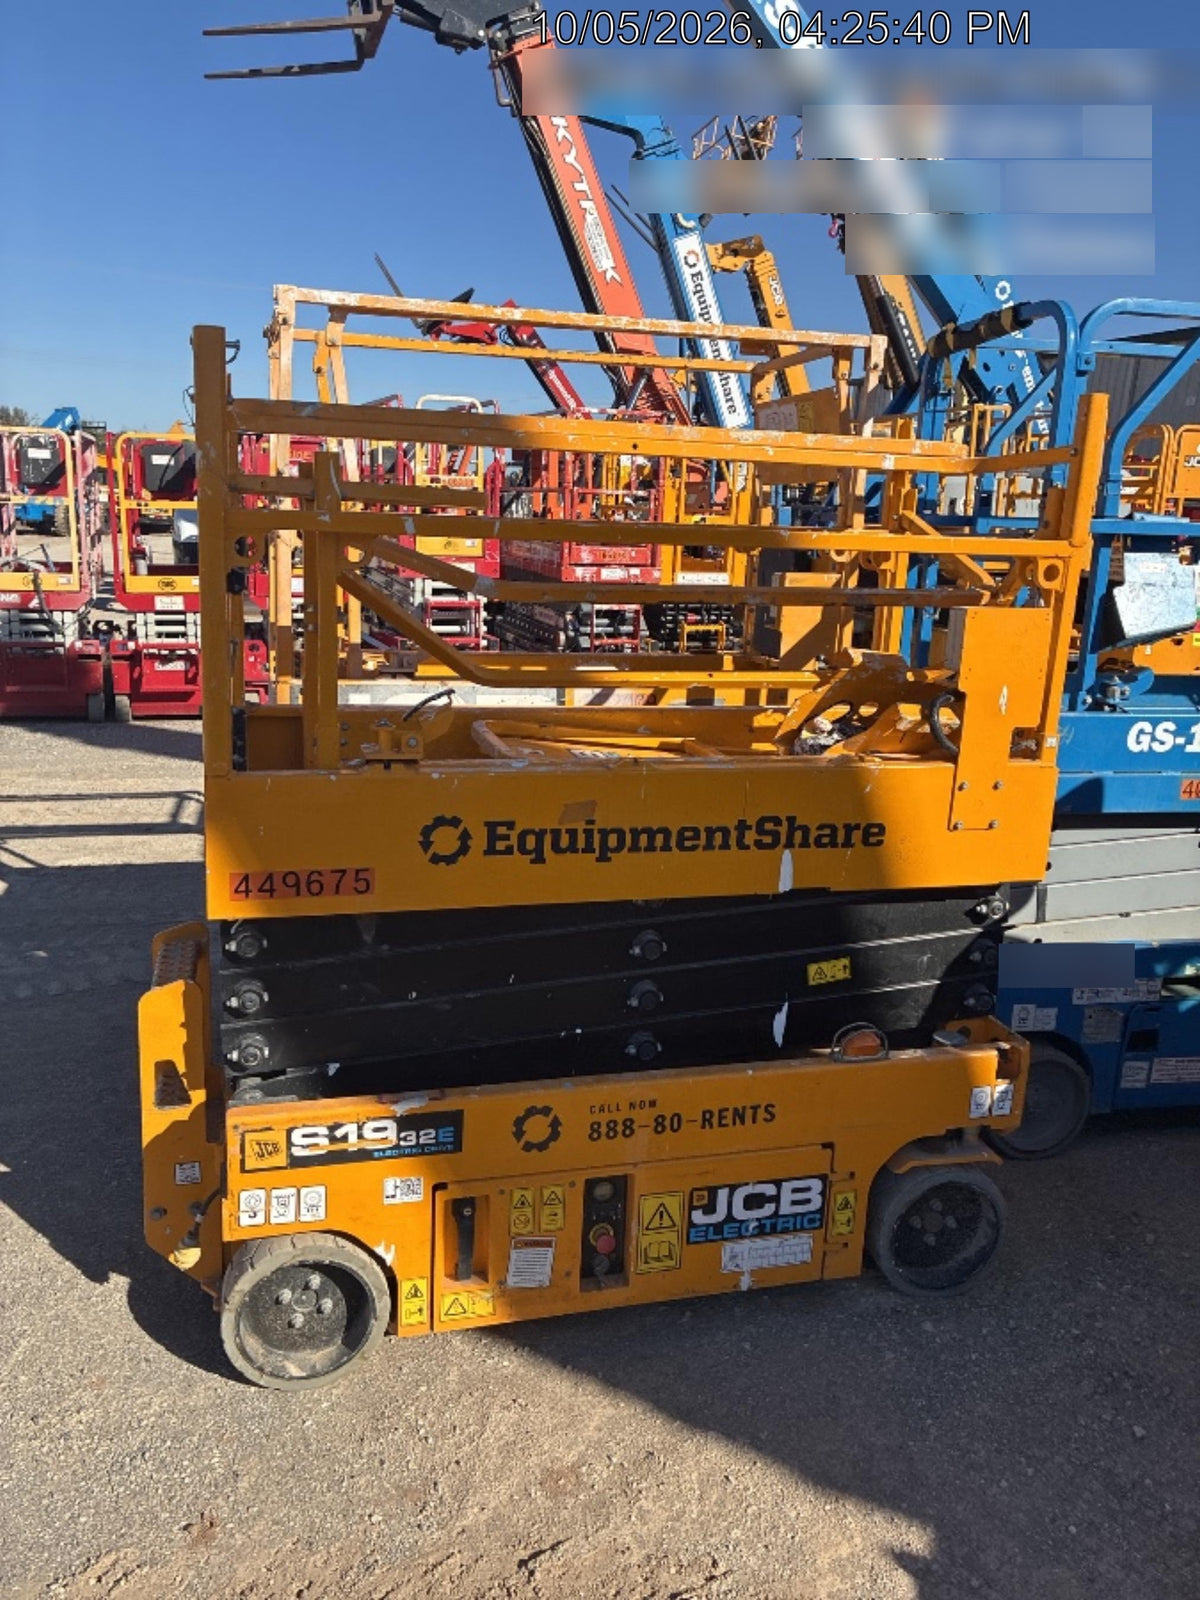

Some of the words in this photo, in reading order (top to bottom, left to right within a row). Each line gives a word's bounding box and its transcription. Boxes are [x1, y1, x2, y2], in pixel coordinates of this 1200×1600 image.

[482, 815, 887, 865] EquipmentShare
[233, 866, 371, 899] 449675
[588, 1103, 777, 1142] 888-80-RENTS
[589, 1102, 623, 1115] CALL
[628, 1098, 658, 1111] NOW
[254, 1139, 281, 1160] JCB
[691, 1178, 823, 1225] JCB
[688, 1212, 822, 1243] ELECTRIC
